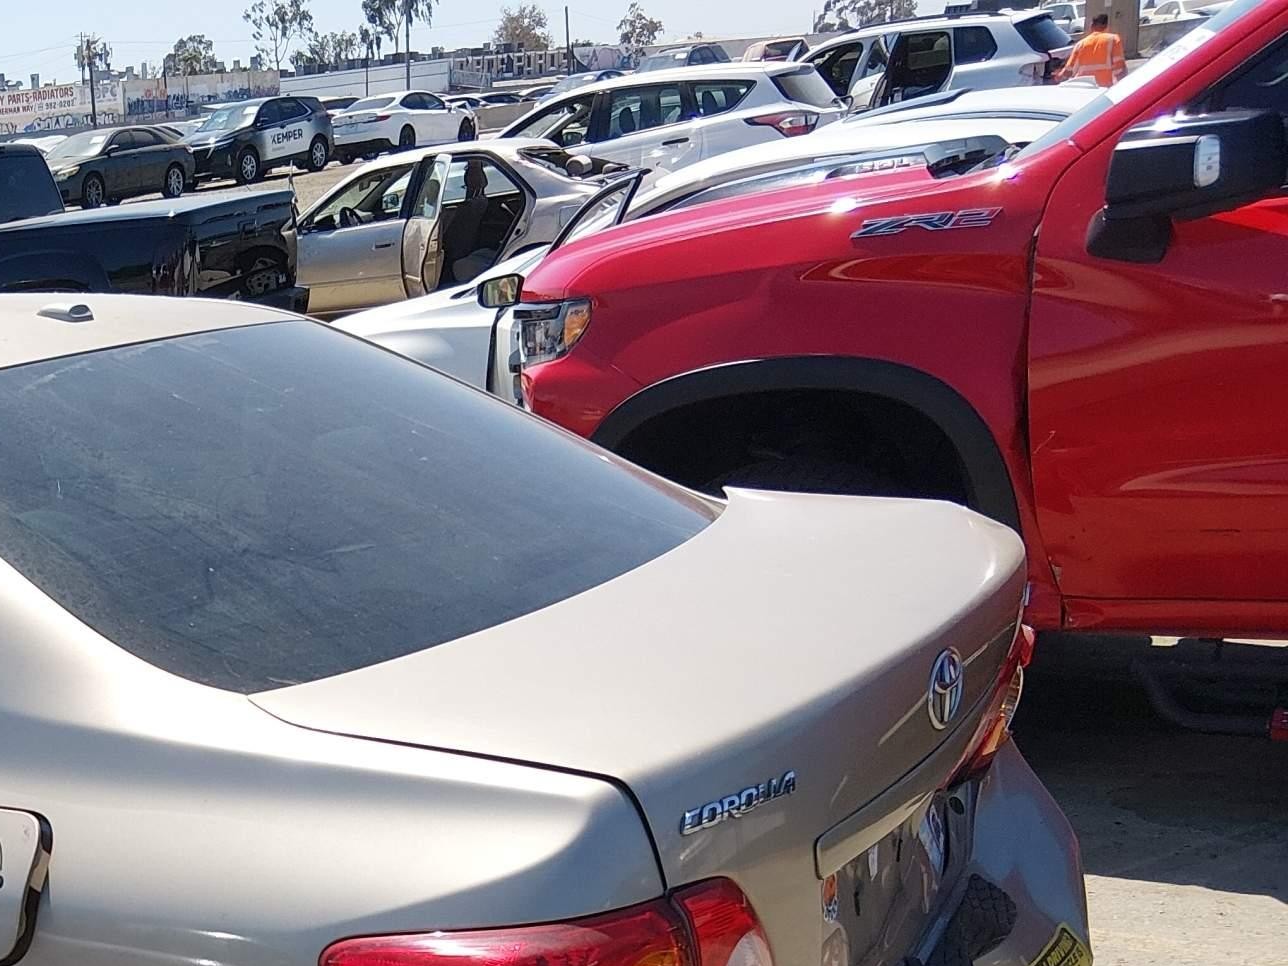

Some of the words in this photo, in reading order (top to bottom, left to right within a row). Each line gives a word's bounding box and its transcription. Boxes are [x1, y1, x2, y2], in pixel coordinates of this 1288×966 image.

[22, 103, 33, 113] WAY
[271, 128, 303, 144] KEMPER
[850, 206, 1003, 238] ZR2
[679, 770, 797, 836] COROLLA
